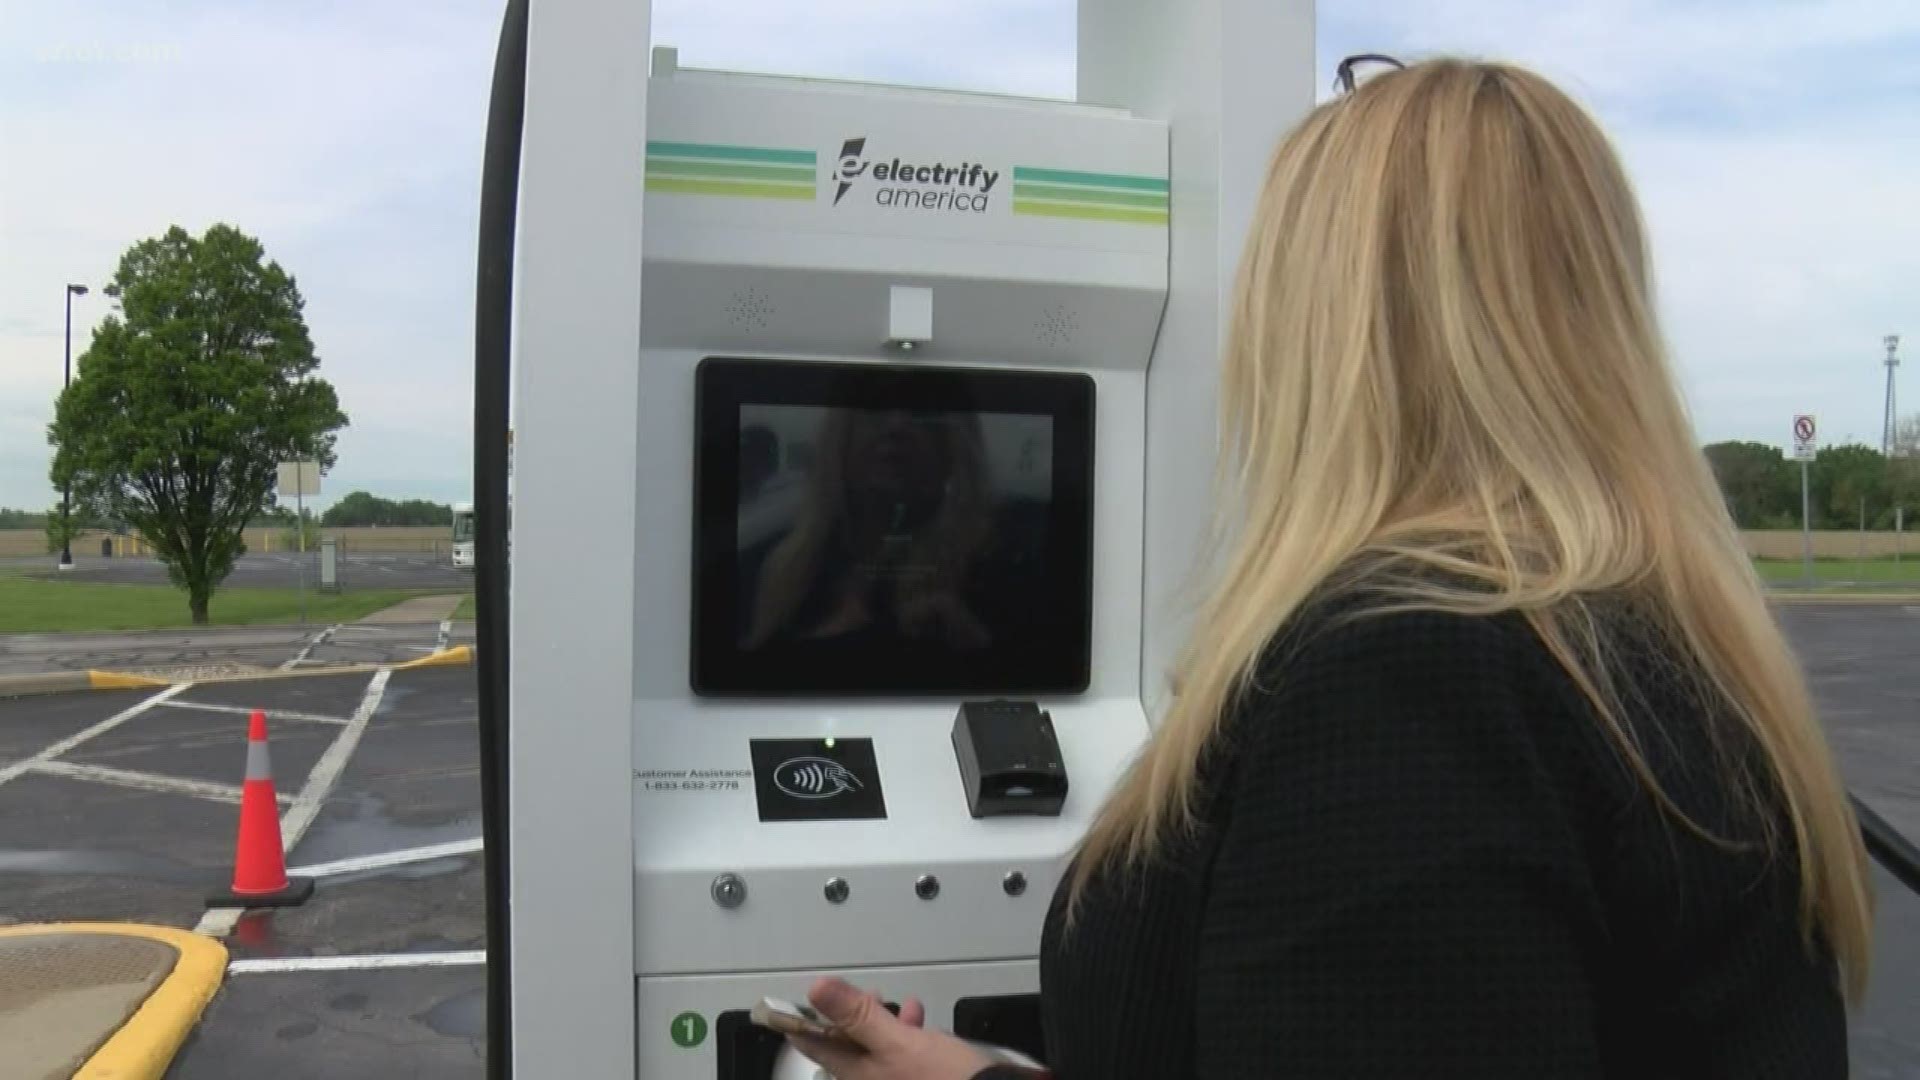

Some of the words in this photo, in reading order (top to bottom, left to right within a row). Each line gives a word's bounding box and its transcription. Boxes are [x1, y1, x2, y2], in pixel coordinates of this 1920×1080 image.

[872, 158, 998, 193] electrify
[876, 187, 988, 213] america
[645, 780, 739, 791] 1-833-632-2778
[690, 769, 752, 779] Assistance
[682, 1018, 694, 1042] 1
